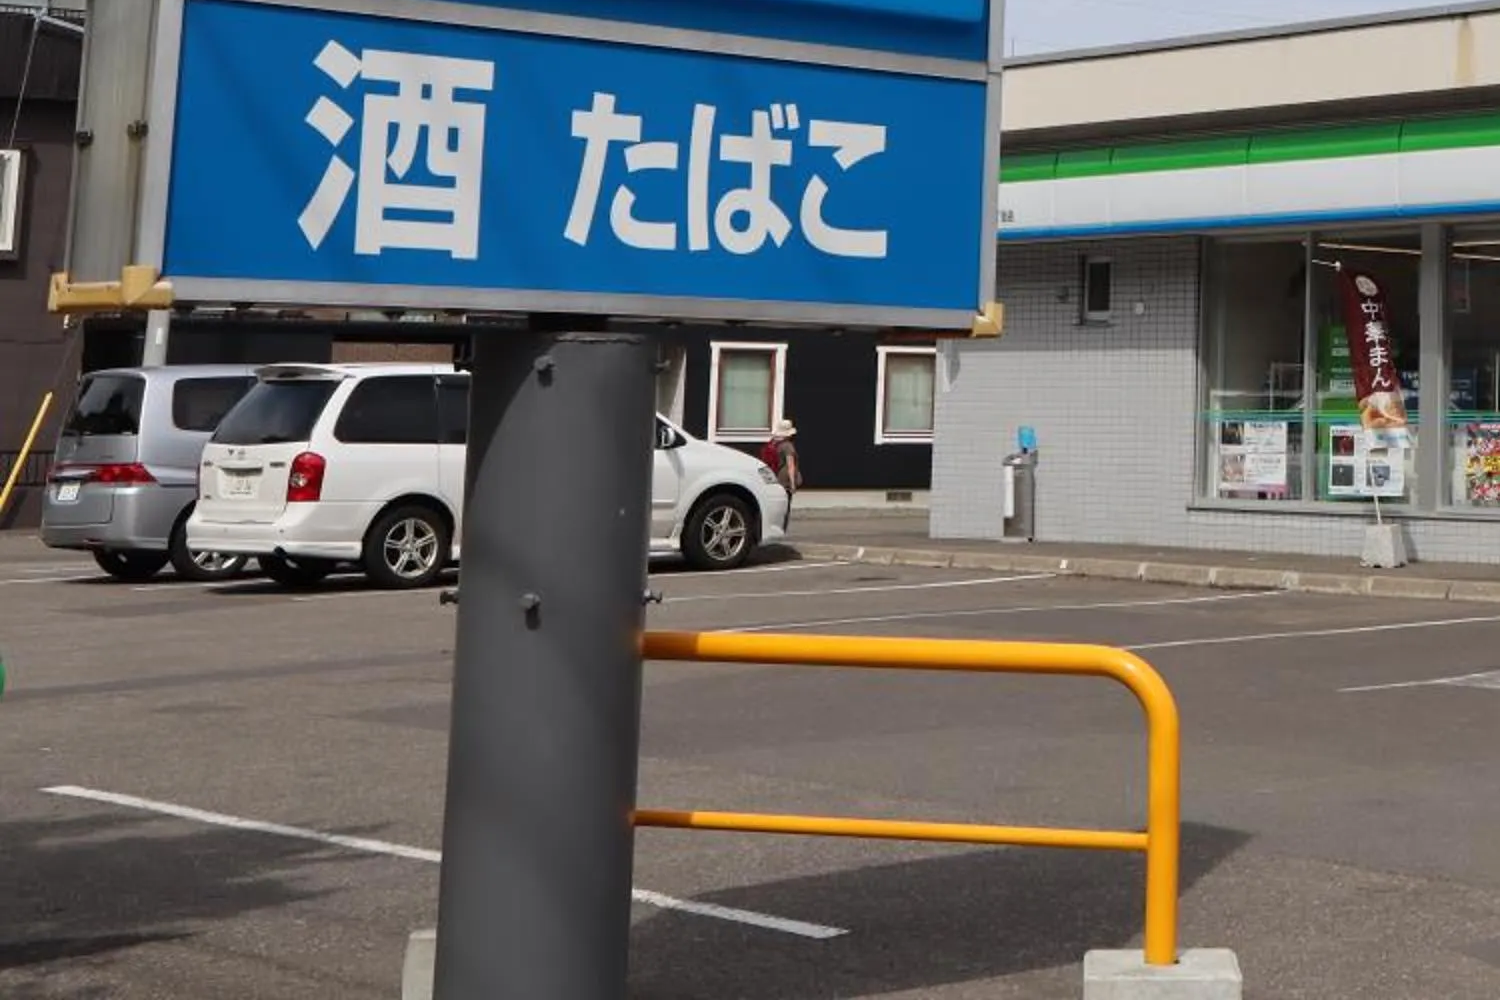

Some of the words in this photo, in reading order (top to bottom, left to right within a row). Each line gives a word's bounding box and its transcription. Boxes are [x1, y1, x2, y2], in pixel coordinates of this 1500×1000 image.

[297, 39, 496, 261] 酒
[564, 92, 888, 259] たばこ
[1360, 298, 1392, 389] 中華まん
